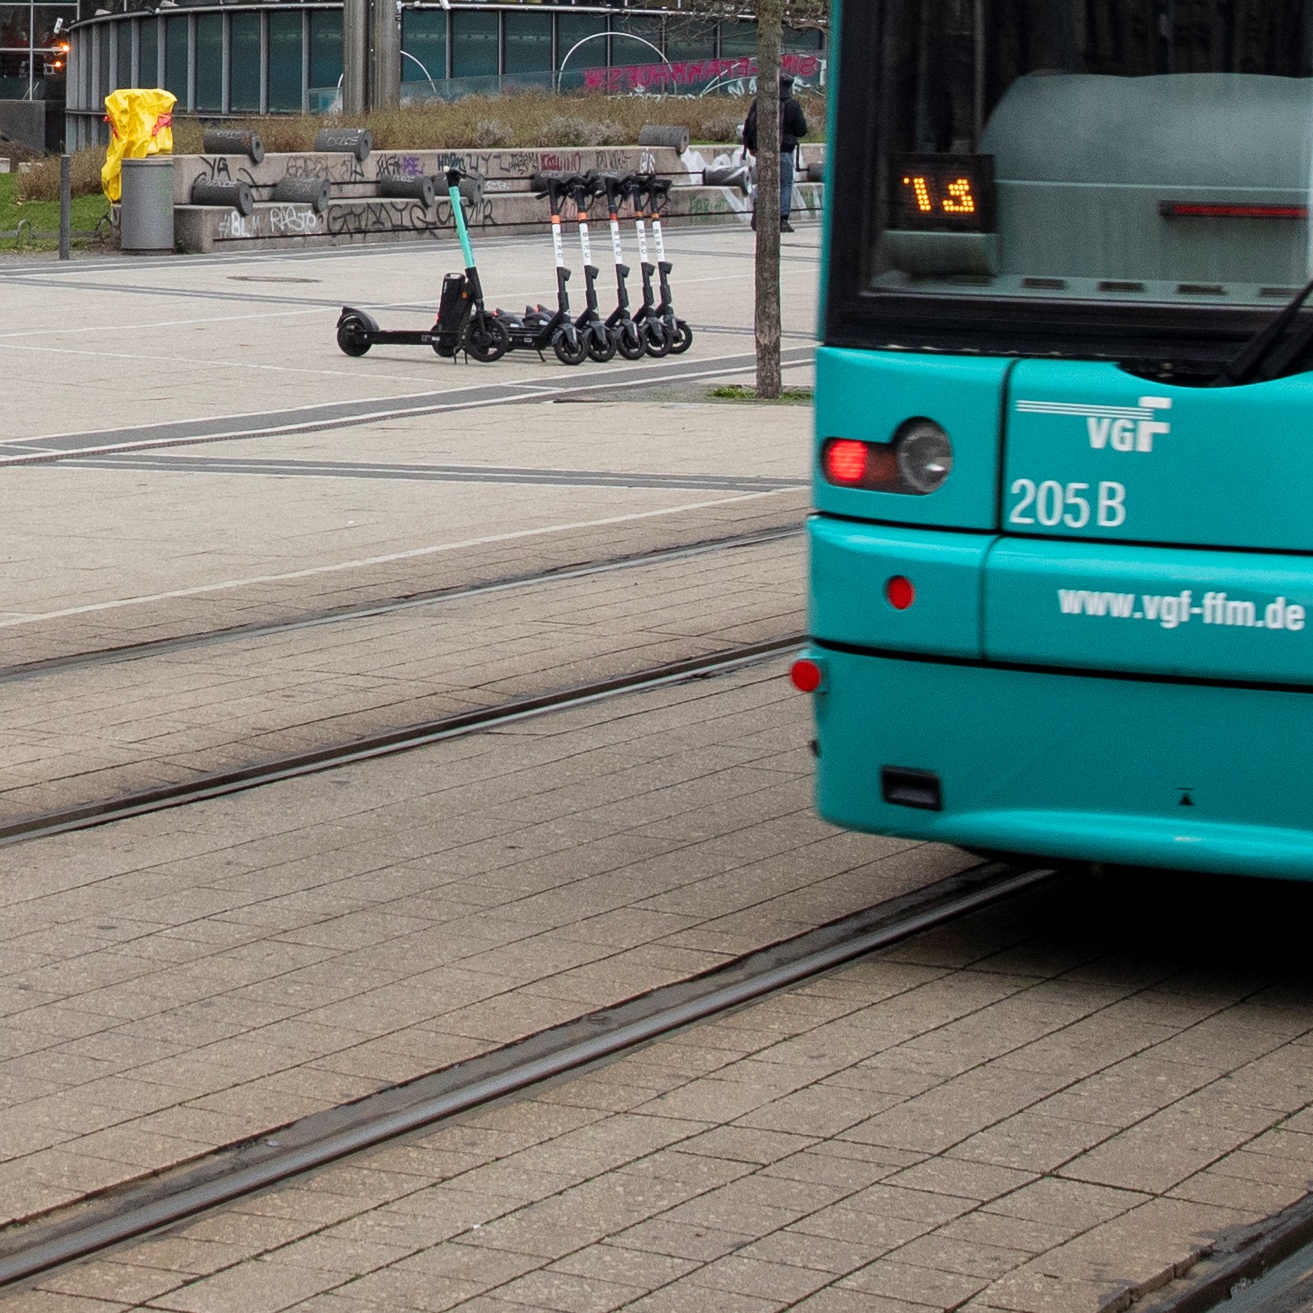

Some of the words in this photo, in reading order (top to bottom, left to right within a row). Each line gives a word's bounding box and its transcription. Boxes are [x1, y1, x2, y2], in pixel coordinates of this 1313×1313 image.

[1087, 395, 1173, 453] VGF
[1009, 478, 1091, 529] 205
[1097, 481, 1127, 527] B
[1057, 588, 1306, 631] www.vgf-ffm.de
